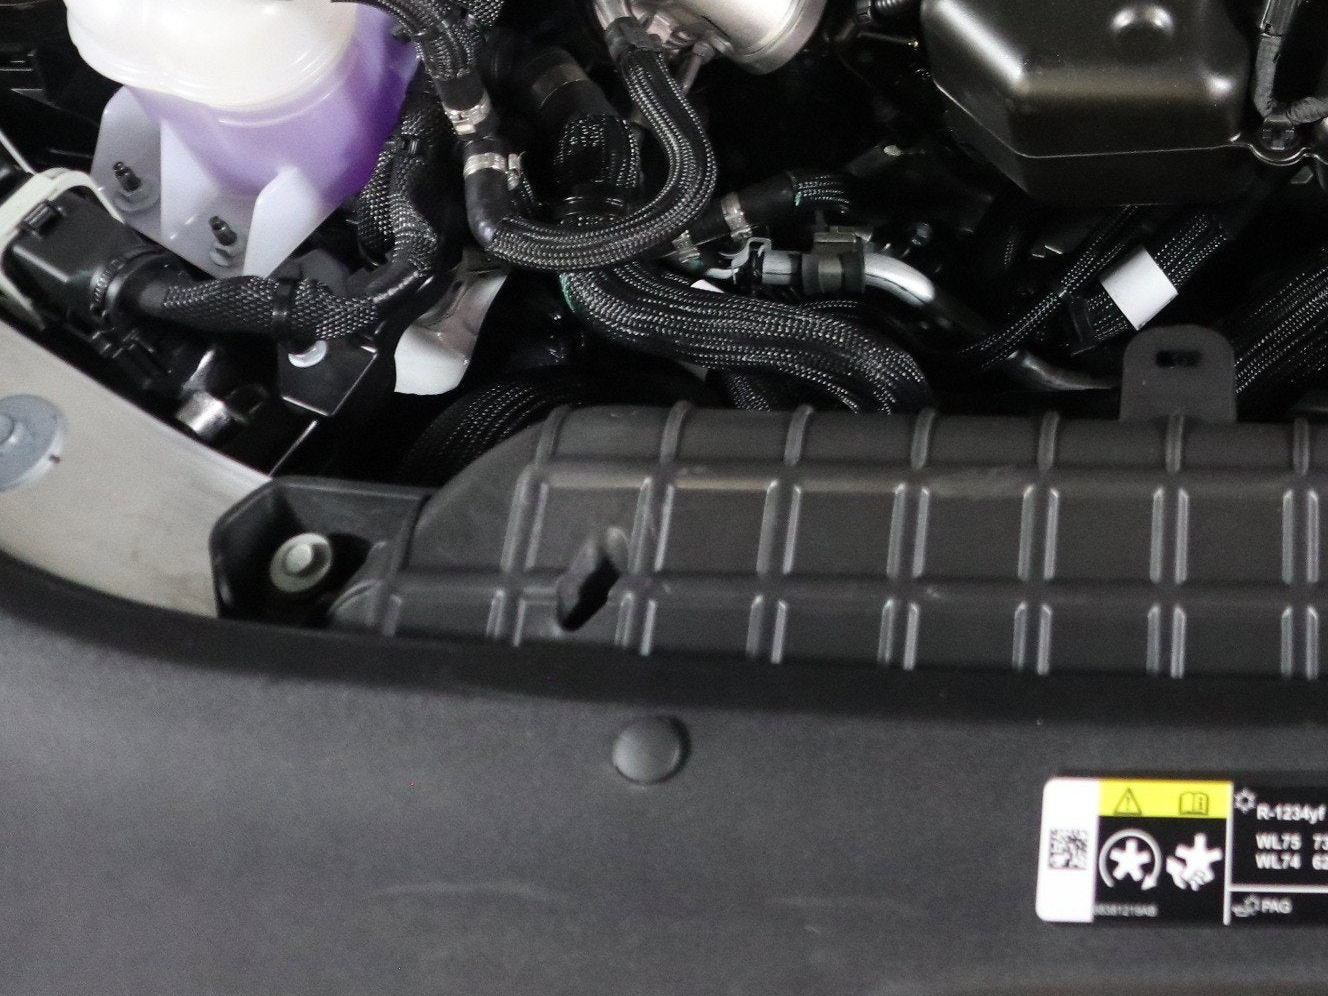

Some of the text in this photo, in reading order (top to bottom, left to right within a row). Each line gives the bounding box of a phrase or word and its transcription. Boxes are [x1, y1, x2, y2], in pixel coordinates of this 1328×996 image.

[1256, 804, 1326, 824] R-1234yf
[1256, 834, 1301, 850] WL75
[1256, 853, 1301, 869] WL74
[1262, 898, 1292, 913] PAG
